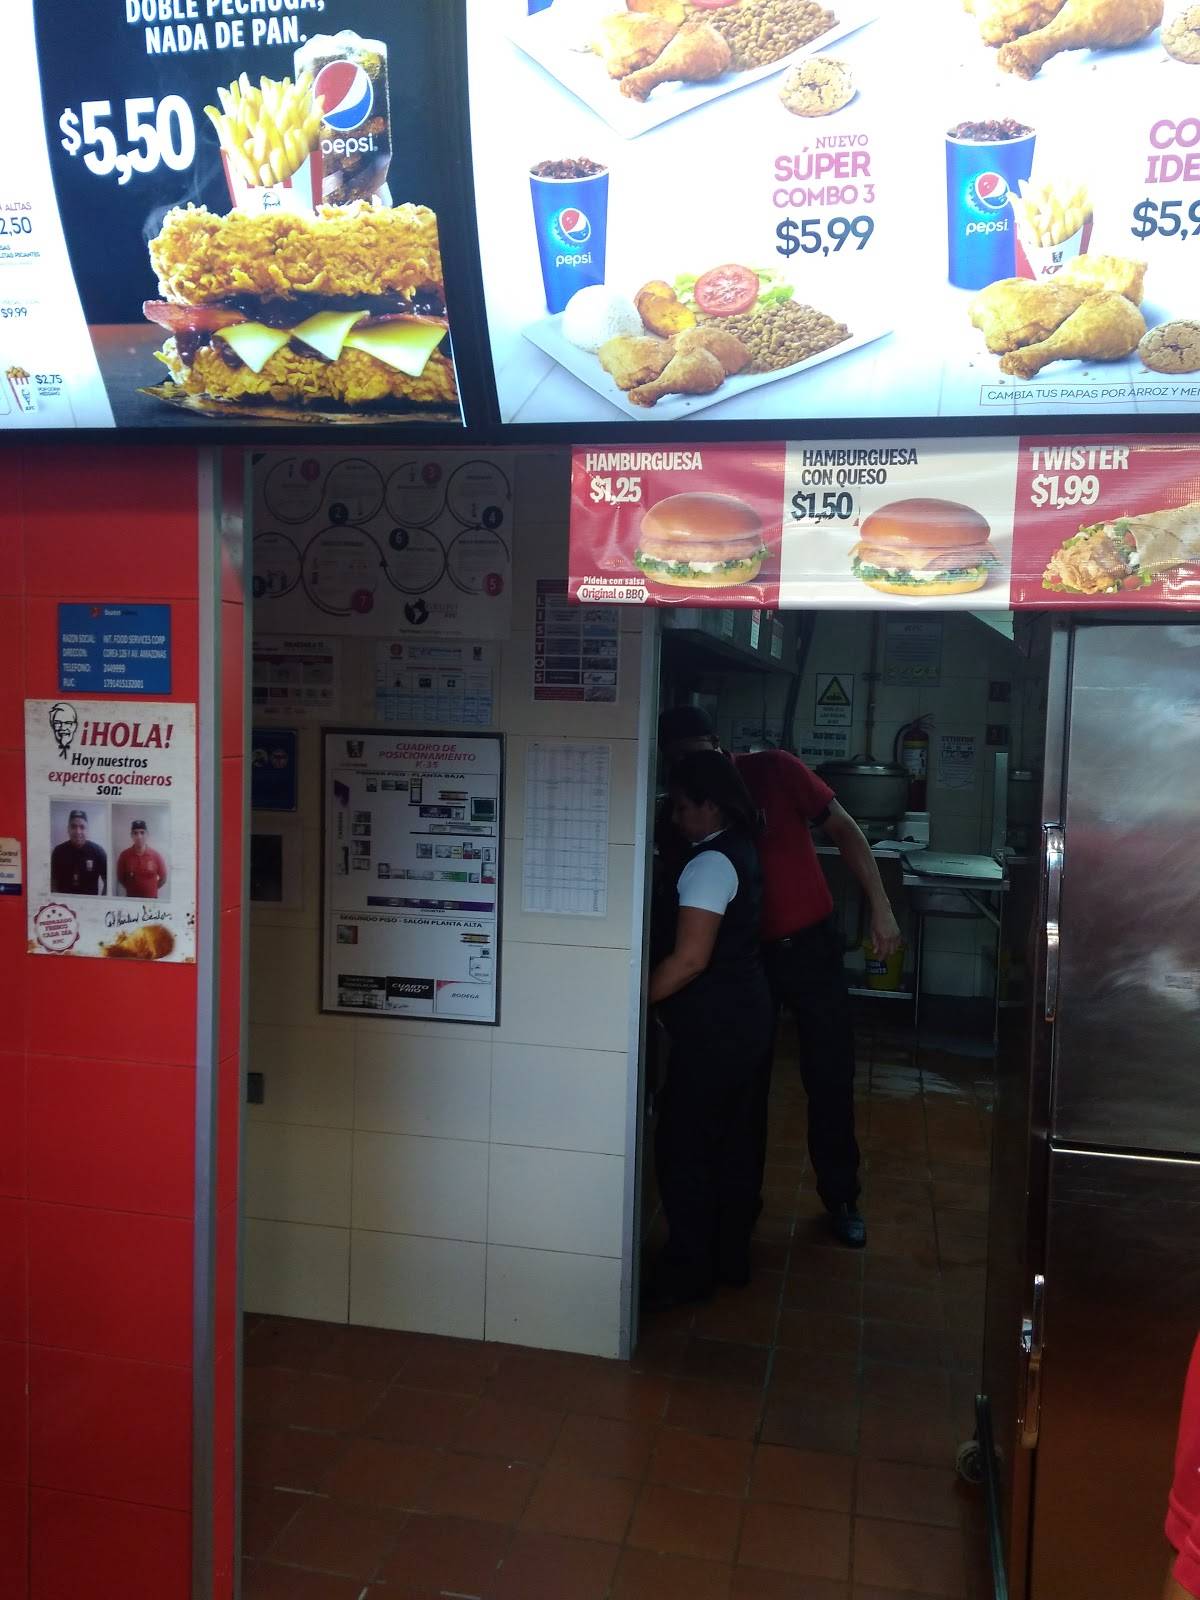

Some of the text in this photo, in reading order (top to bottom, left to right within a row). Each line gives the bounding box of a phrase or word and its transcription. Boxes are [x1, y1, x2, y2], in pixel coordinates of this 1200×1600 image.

[125, 0, 325, 23] DOBLE PECH,
[145, 15, 307, 54] NADA DE PAN.
[58, 94, 196, 185] $5,50
[815, 134, 869, 149] NUEVO
[1149, 117, 1200, 149] CO
[321, 132, 375, 158] pepsi
[773, 146, 871, 182] SÚPER
[1144, 152, 1200, 184] IDE
[772, 183, 876, 208] COMBO 3
[5, 201, 32, 211] ALITAS
[775, 215, 875, 258] $5,99
[965, 219, 1008, 236] pepsi
[555, 251, 592, 268] pepsi
[1040, 264, 1063, 275] KF
[987, 390, 1034, 400] CAMBIA
[1035, 389, 1058, 398] TUS
[1060, 389, 1098, 399] PAPAS
[1101, 389, 1126, 398] POR
[1128, 387, 1169, 397] ARROZ
[1171, 387, 1179, 396] Y
[586, 451, 703, 472] HAMBURGUESA
[802, 448, 918, 467] HAMBURGUESA
[1029, 446, 1130, 471] TWISTER
[801, 468, 888, 488] CON QUESO
[589, 475, 642, 505] $1,25
[1030, 473, 1100, 509] $1,99
[583, 575, 607, 584] Pídela
[624, 577, 645, 585] salsa
[582, 588, 616, 600] Original
[626, 589, 644, 600] BBQ
[79, 721, 174, 749] ¡HOLA!
[379, 751, 477, 762] POSICIONAMIENTO
[396, 743, 457, 752] CUADRO DE
[71, 753, 148, 770] Hoy nuestros
[48, 770, 173, 787] expertos cocineros
[96, 785, 122, 795] son:
[431, 919, 462, 927] PLANTA
